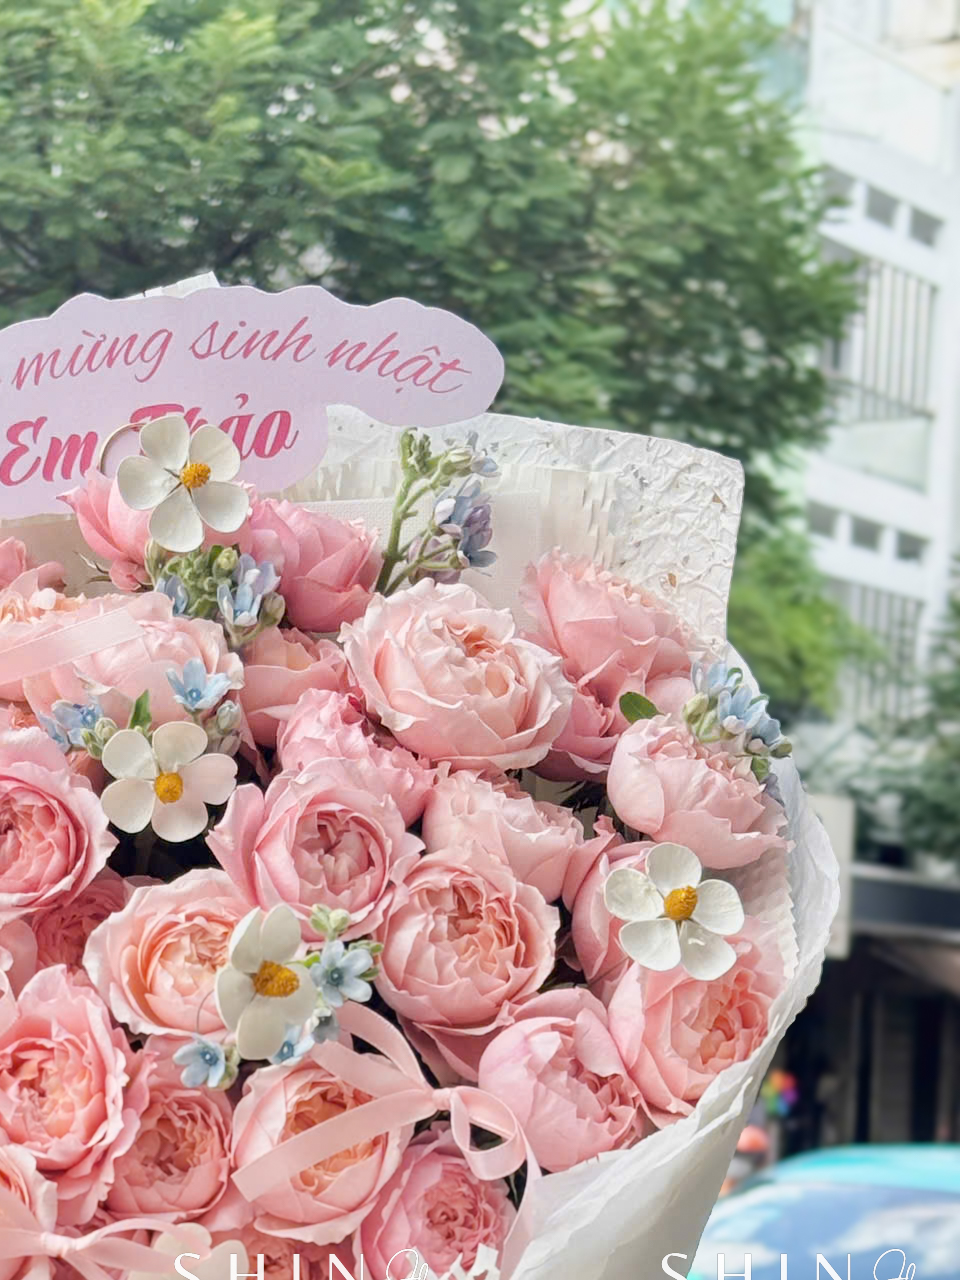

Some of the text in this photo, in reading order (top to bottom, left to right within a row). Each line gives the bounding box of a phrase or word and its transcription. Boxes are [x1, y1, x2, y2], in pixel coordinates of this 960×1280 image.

[11, 328, 174, 391] mừng
[189, 316, 317, 363] sinh
[324, 331, 472, 394] nhật
